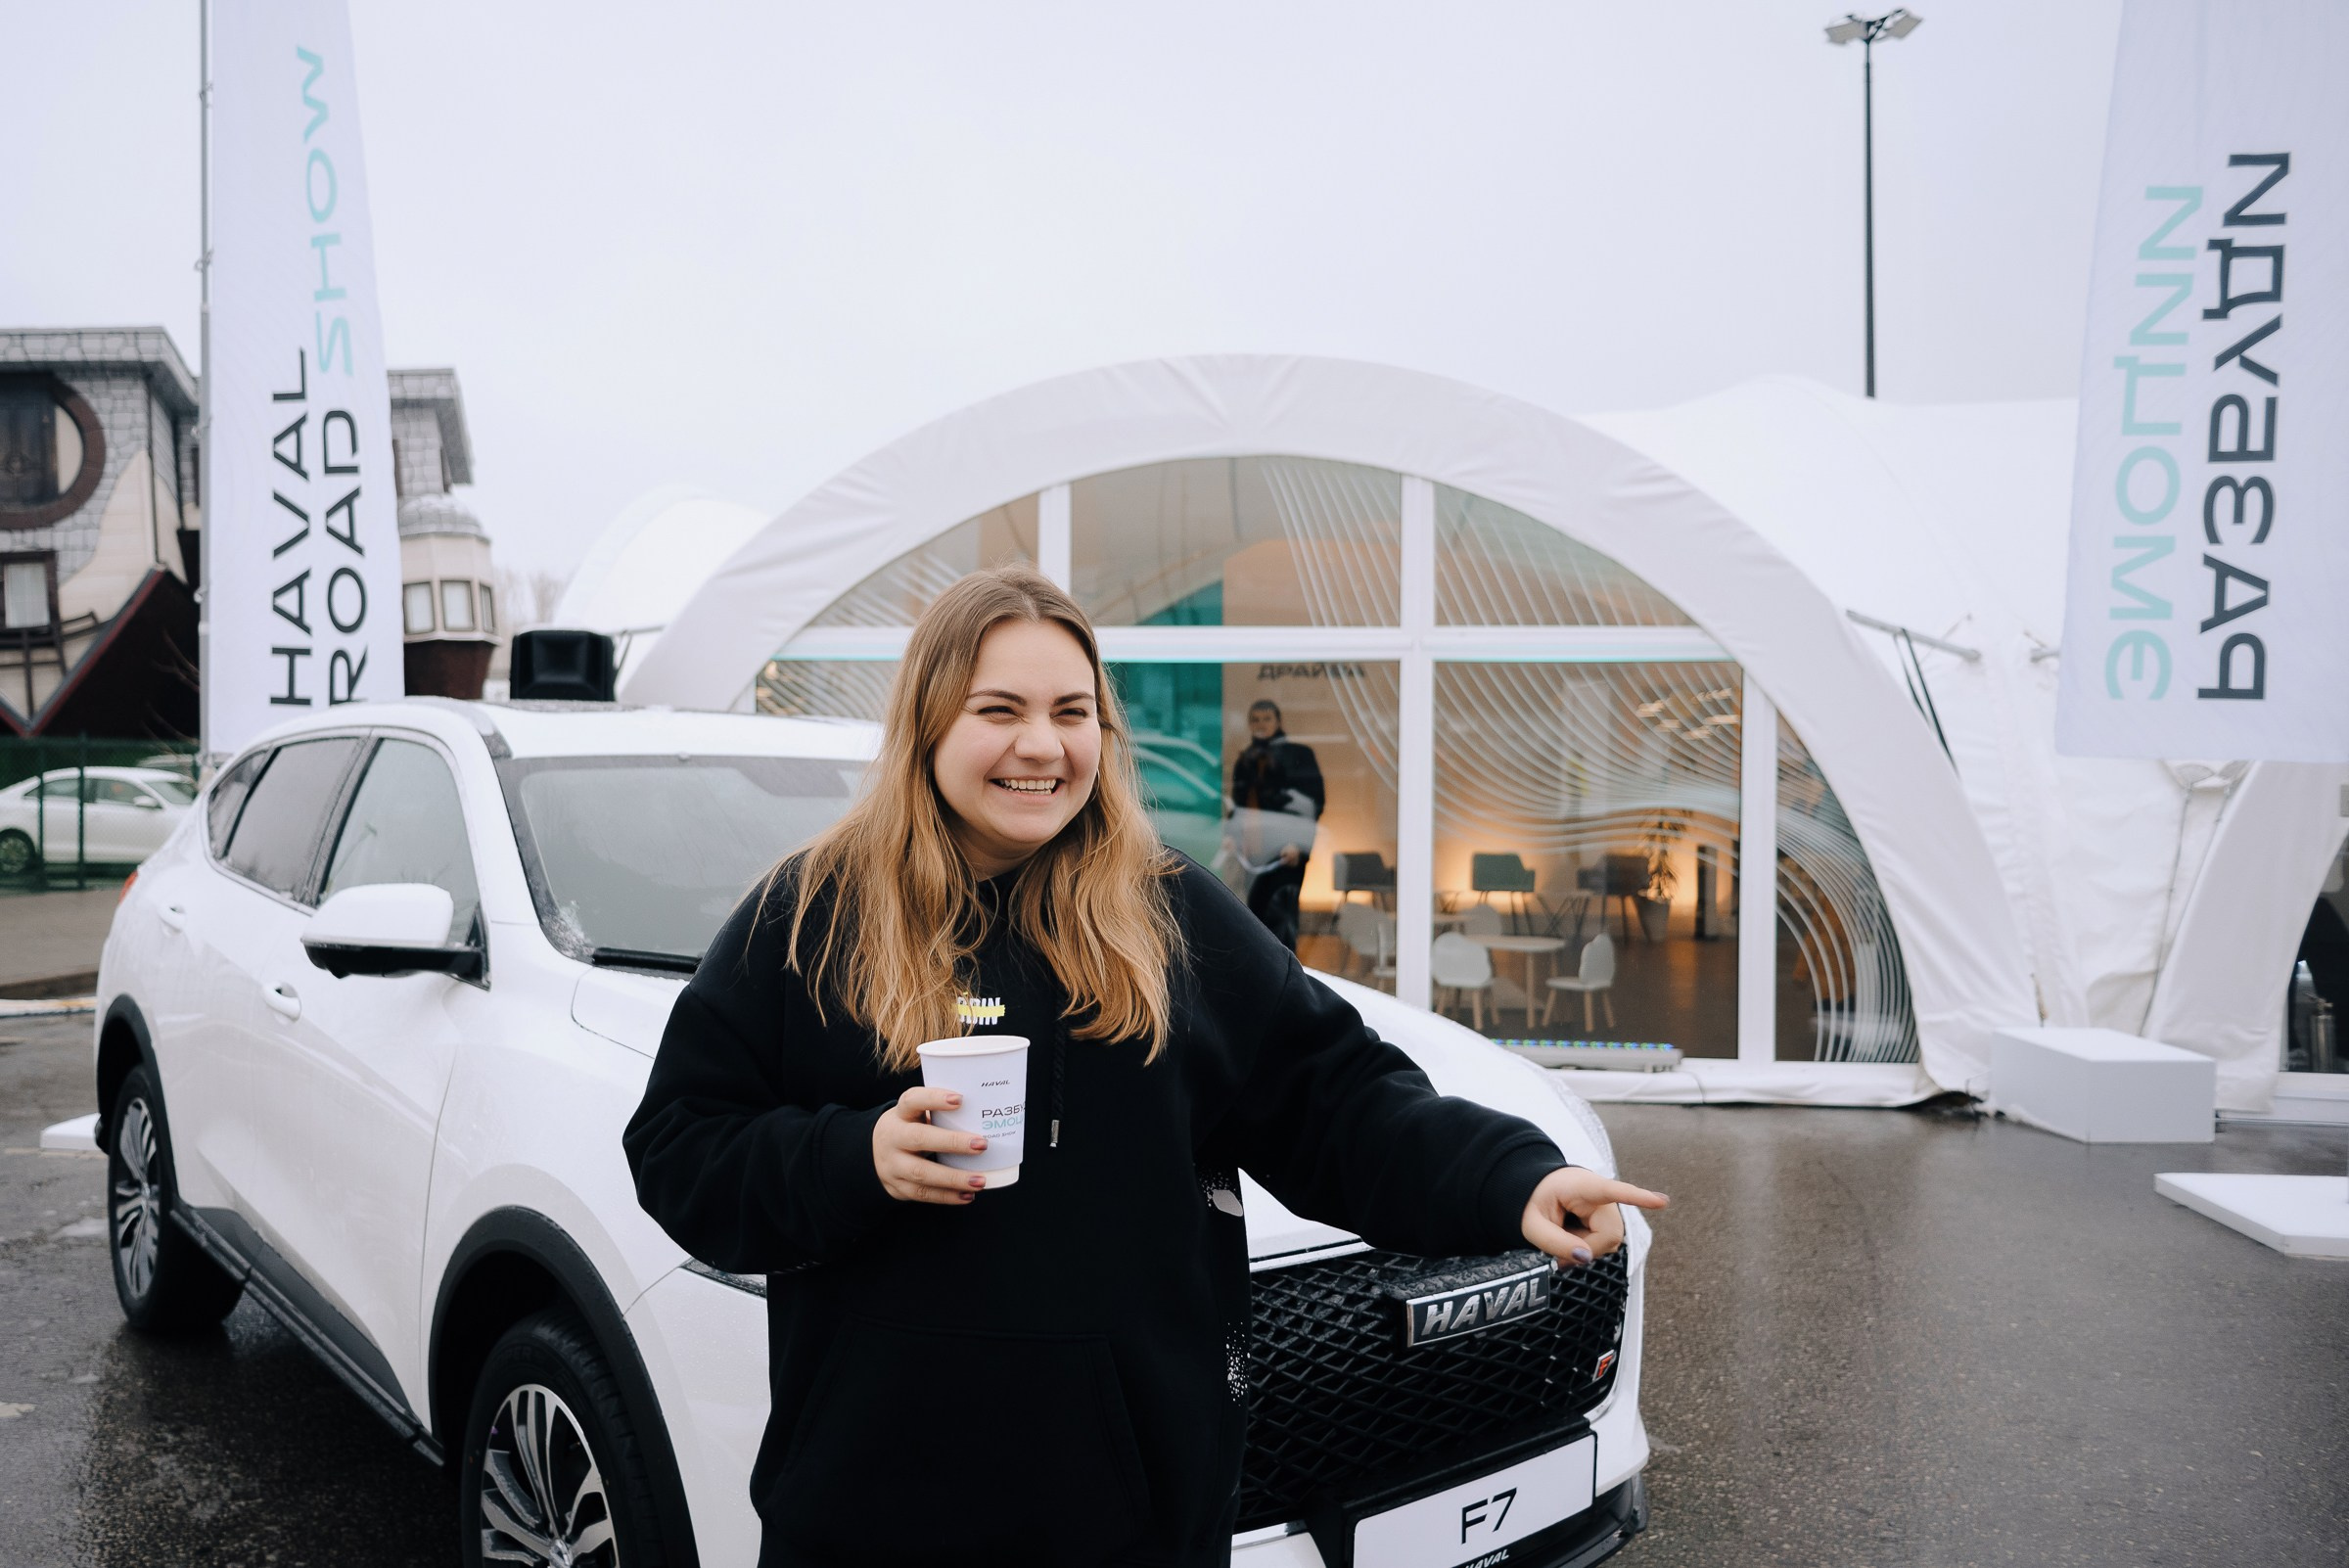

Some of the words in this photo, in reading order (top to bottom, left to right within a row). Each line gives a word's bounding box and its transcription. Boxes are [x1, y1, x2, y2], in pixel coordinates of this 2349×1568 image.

[297, 46, 354, 378] SHOW
[270, 348, 312, 707] HAVAL
[322, 409, 368, 707] ROAD
[982, 1102, 1026, 1119] РАЗБУ
[1421, 1277, 1546, 1336] HAVAL
[1461, 1487, 1518, 1545] F7
